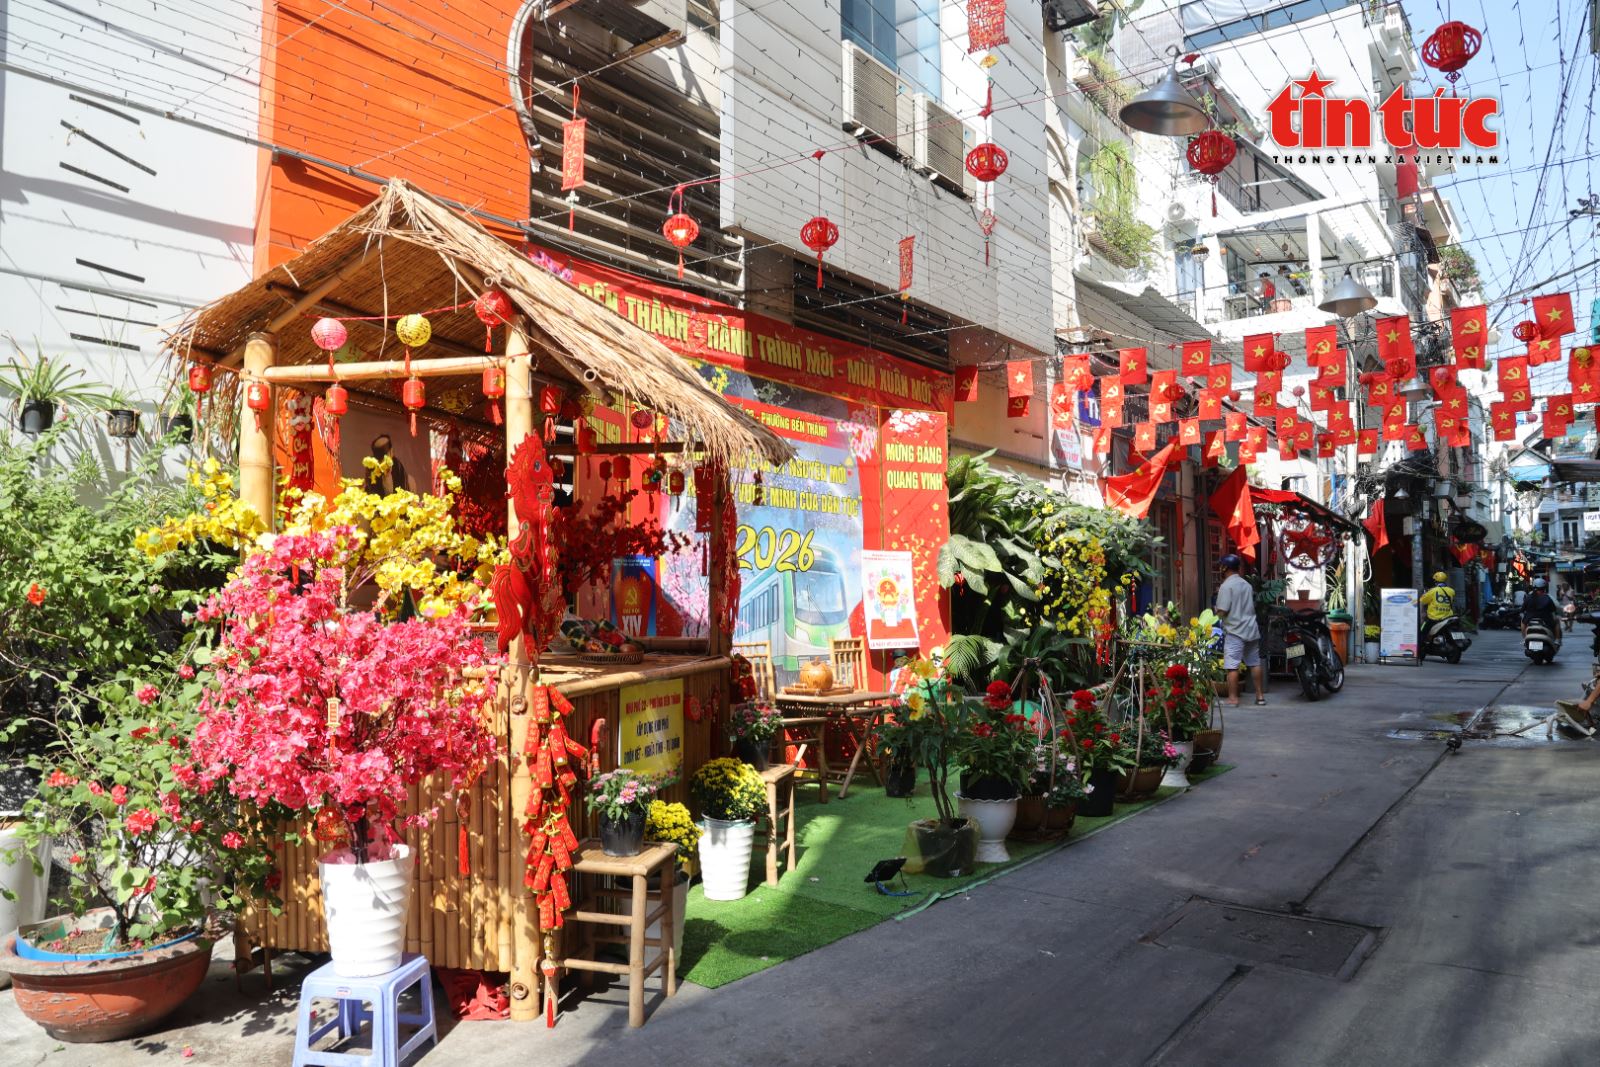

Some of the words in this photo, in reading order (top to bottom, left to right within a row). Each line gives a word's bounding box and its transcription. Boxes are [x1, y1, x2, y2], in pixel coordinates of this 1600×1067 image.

[625, 297, 689, 342] THÀNH
[707, 317, 753, 358] HÀNH
[757, 333, 803, 370] TRÌNH
[806, 346, 834, 378] MỚI
[847, 357, 876, 389] MÙA
[879, 367, 908, 399] XUÂN
[761, 412, 790, 430] PHƯỜNG
[792, 417, 805, 433] BẾN
[806, 421, 828, 438] THÀNH
[886, 440, 914, 463] MỪNG
[917, 440, 942, 465] ĐẢNG
[829, 463, 848, 485] MỚI
[887, 470, 918, 490] QUANG
[921, 471, 943, 491] VINH
[770, 486, 797, 509] MÌNH
[800, 487, 818, 512] CỦA
[821, 492, 840, 515] DÂN
[736, 524, 815, 573] 2026
[622, 614, 642, 637] XIV
